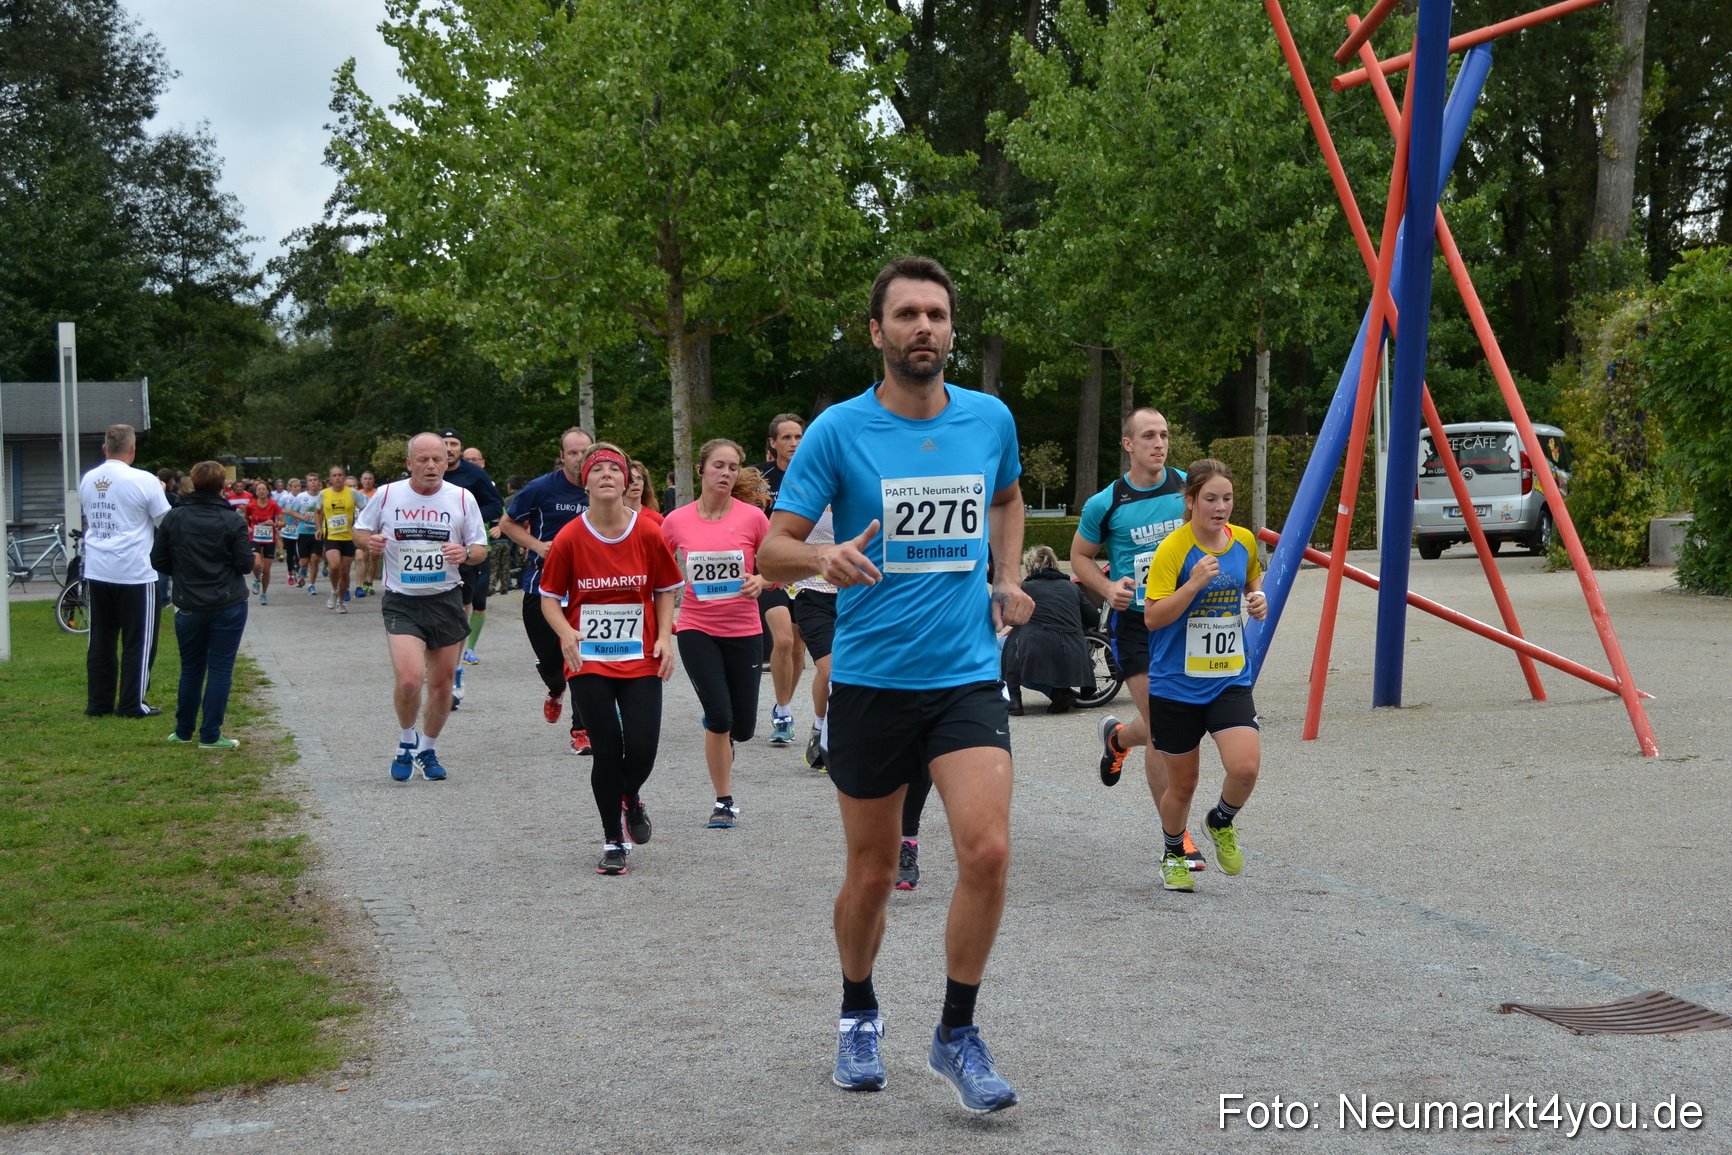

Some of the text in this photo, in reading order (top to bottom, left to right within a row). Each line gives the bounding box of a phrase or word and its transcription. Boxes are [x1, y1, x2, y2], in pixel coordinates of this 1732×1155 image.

[885, 485, 970, 498] PARTL Neumarkt
[395, 505, 451, 524] twinn
[555, 503, 576, 511] EURO
[895, 499, 977, 536] 2276
[1130, 518, 1184, 540] HUBER
[907, 544, 967, 560] Bernhard
[404, 554, 444, 571] 2449
[409, 574, 437, 582] Willfried
[693, 562, 740, 581] 2828
[707, 585, 728, 593] Elena
[587, 618, 638, 640] 2377
[1189, 622, 1211, 630] PARTL
[595, 645, 629, 654] Karoline
[1202, 631, 1236, 655] 102
[1209, 660, 1229, 670] Lena
